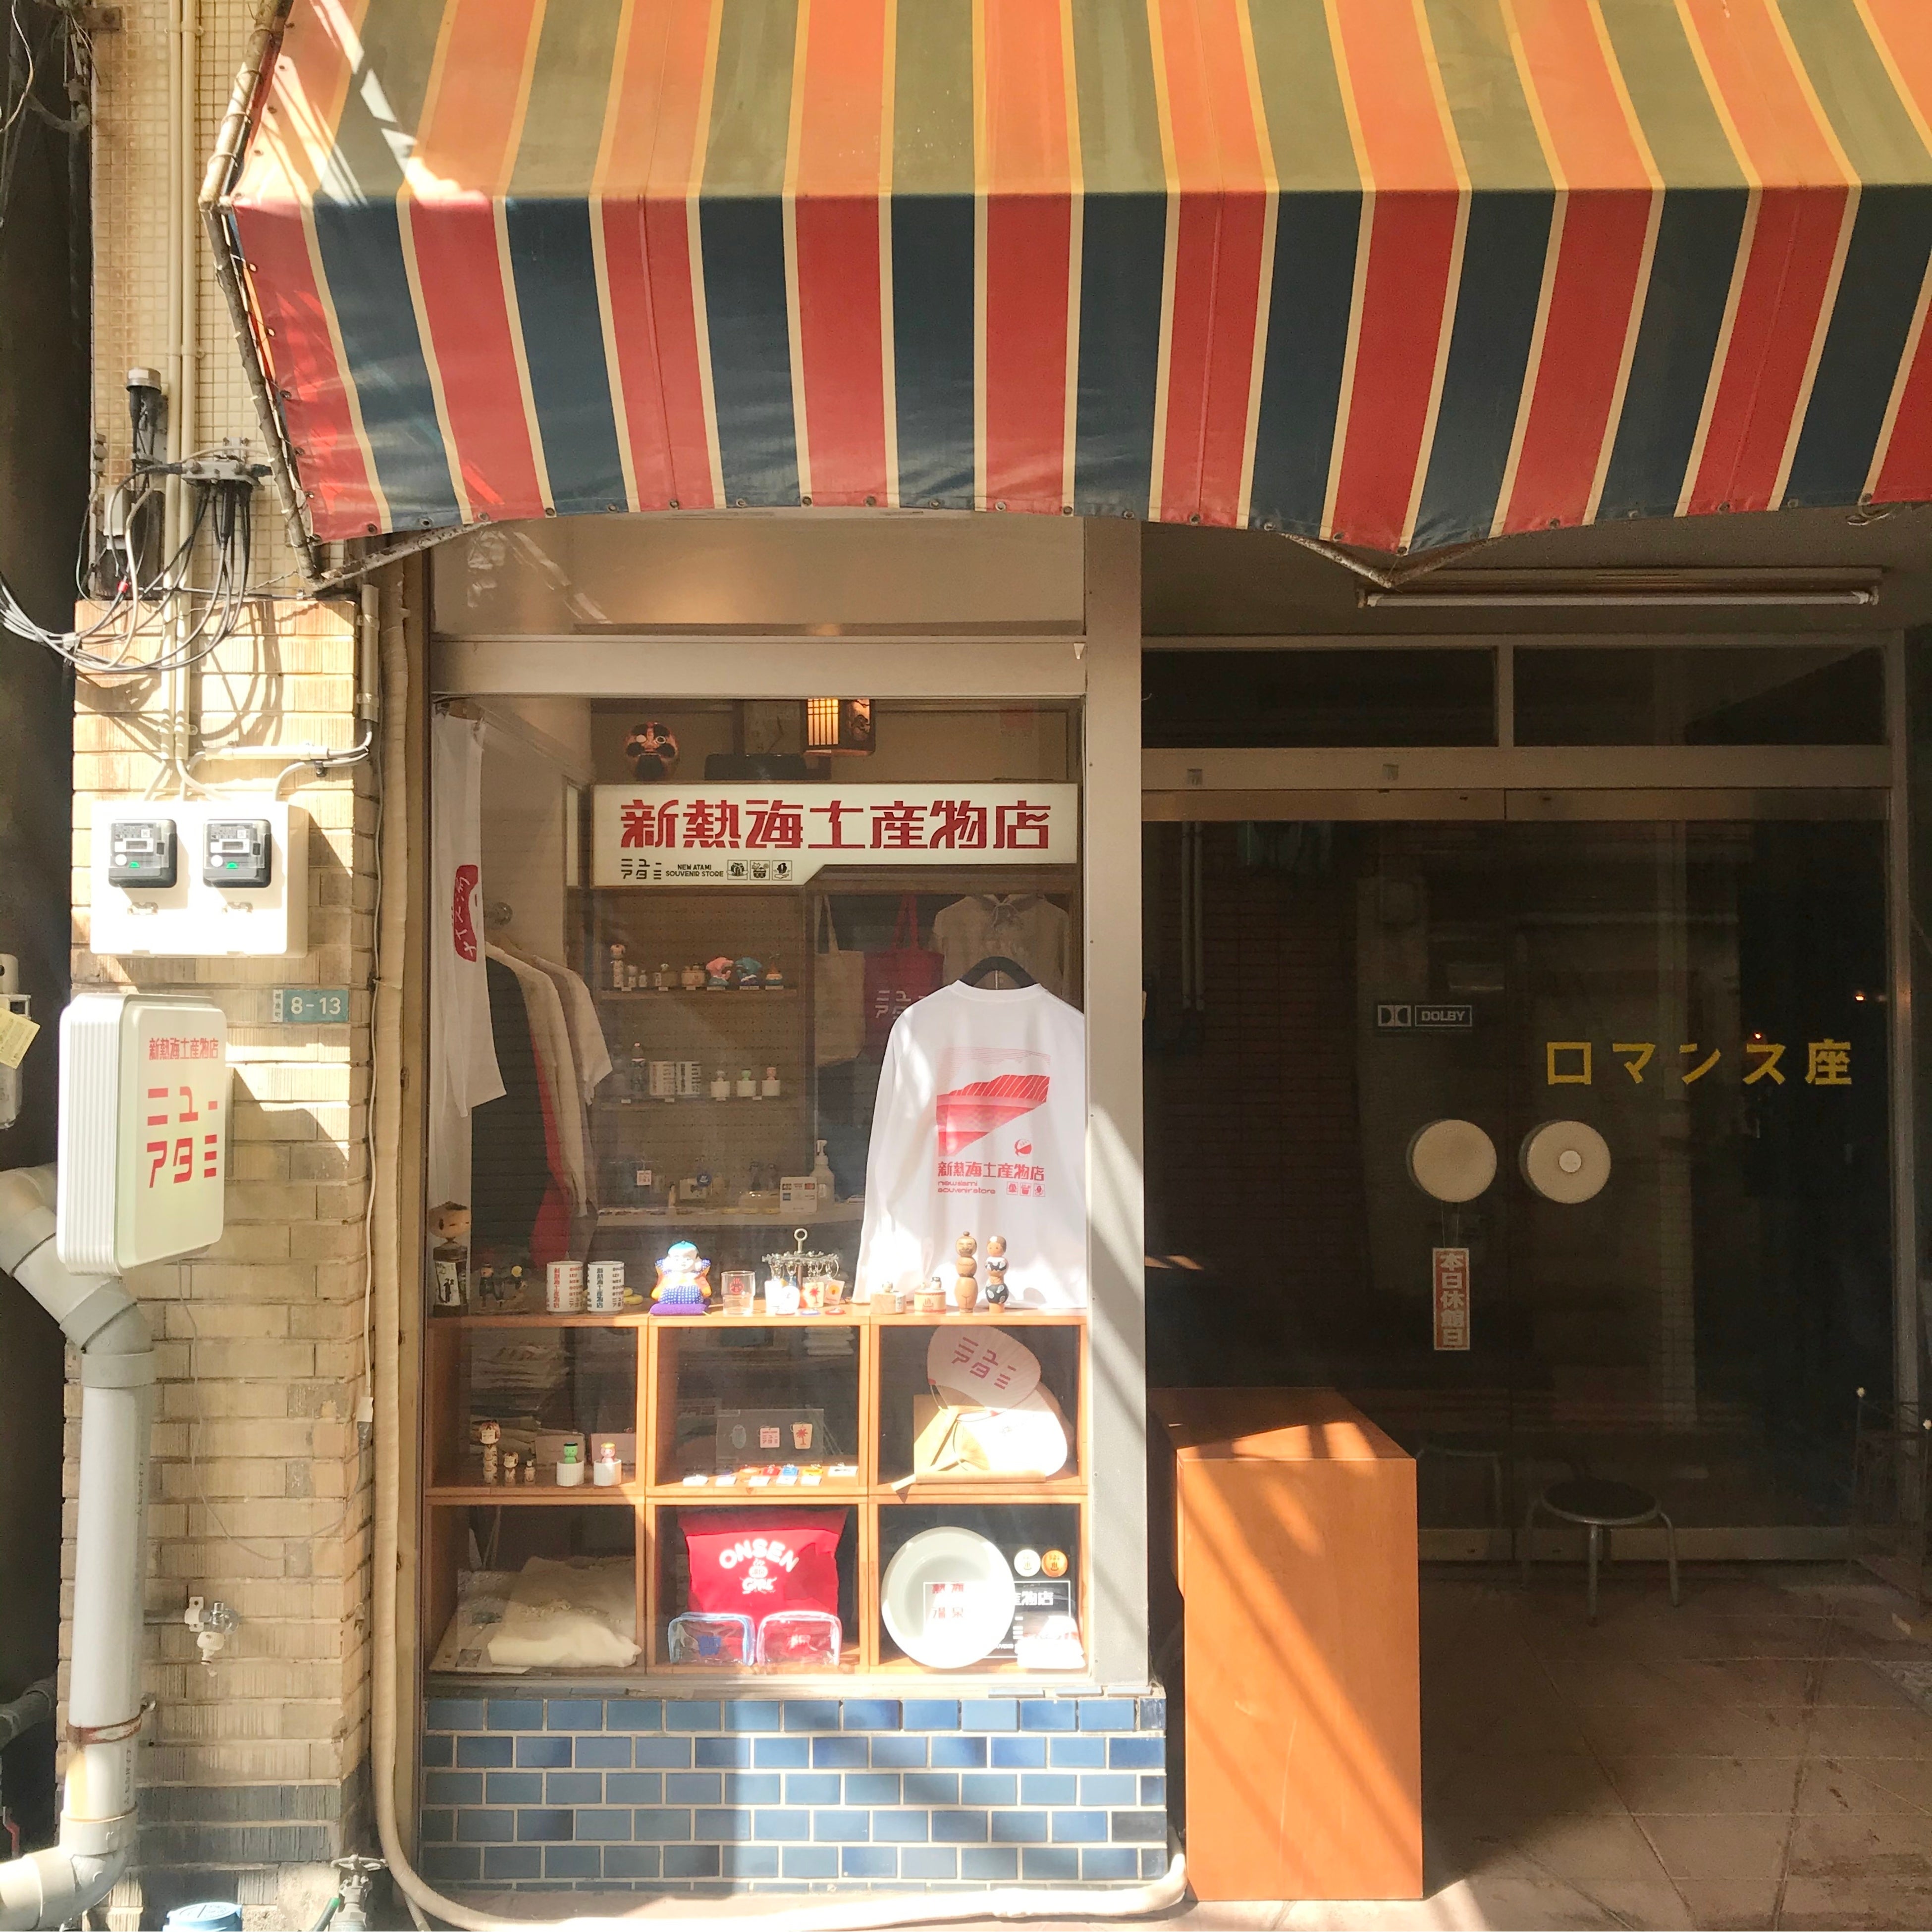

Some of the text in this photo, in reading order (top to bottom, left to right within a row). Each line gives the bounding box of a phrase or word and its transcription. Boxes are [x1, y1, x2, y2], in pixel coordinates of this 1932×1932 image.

[621, 799, 1051, 849] 新熱海土産物店
[291, 996, 341, 1015] 8-13
[1421, 1010, 1465, 1021] DOLBY
[149, 1038, 219, 1060] 新熱海土産物店
[1547, 1039, 1853, 1086] ロマンス座
[938, 1161, 1045, 1181] 新熱海土産物店
[719, 1538, 800, 1573] ONSEN
